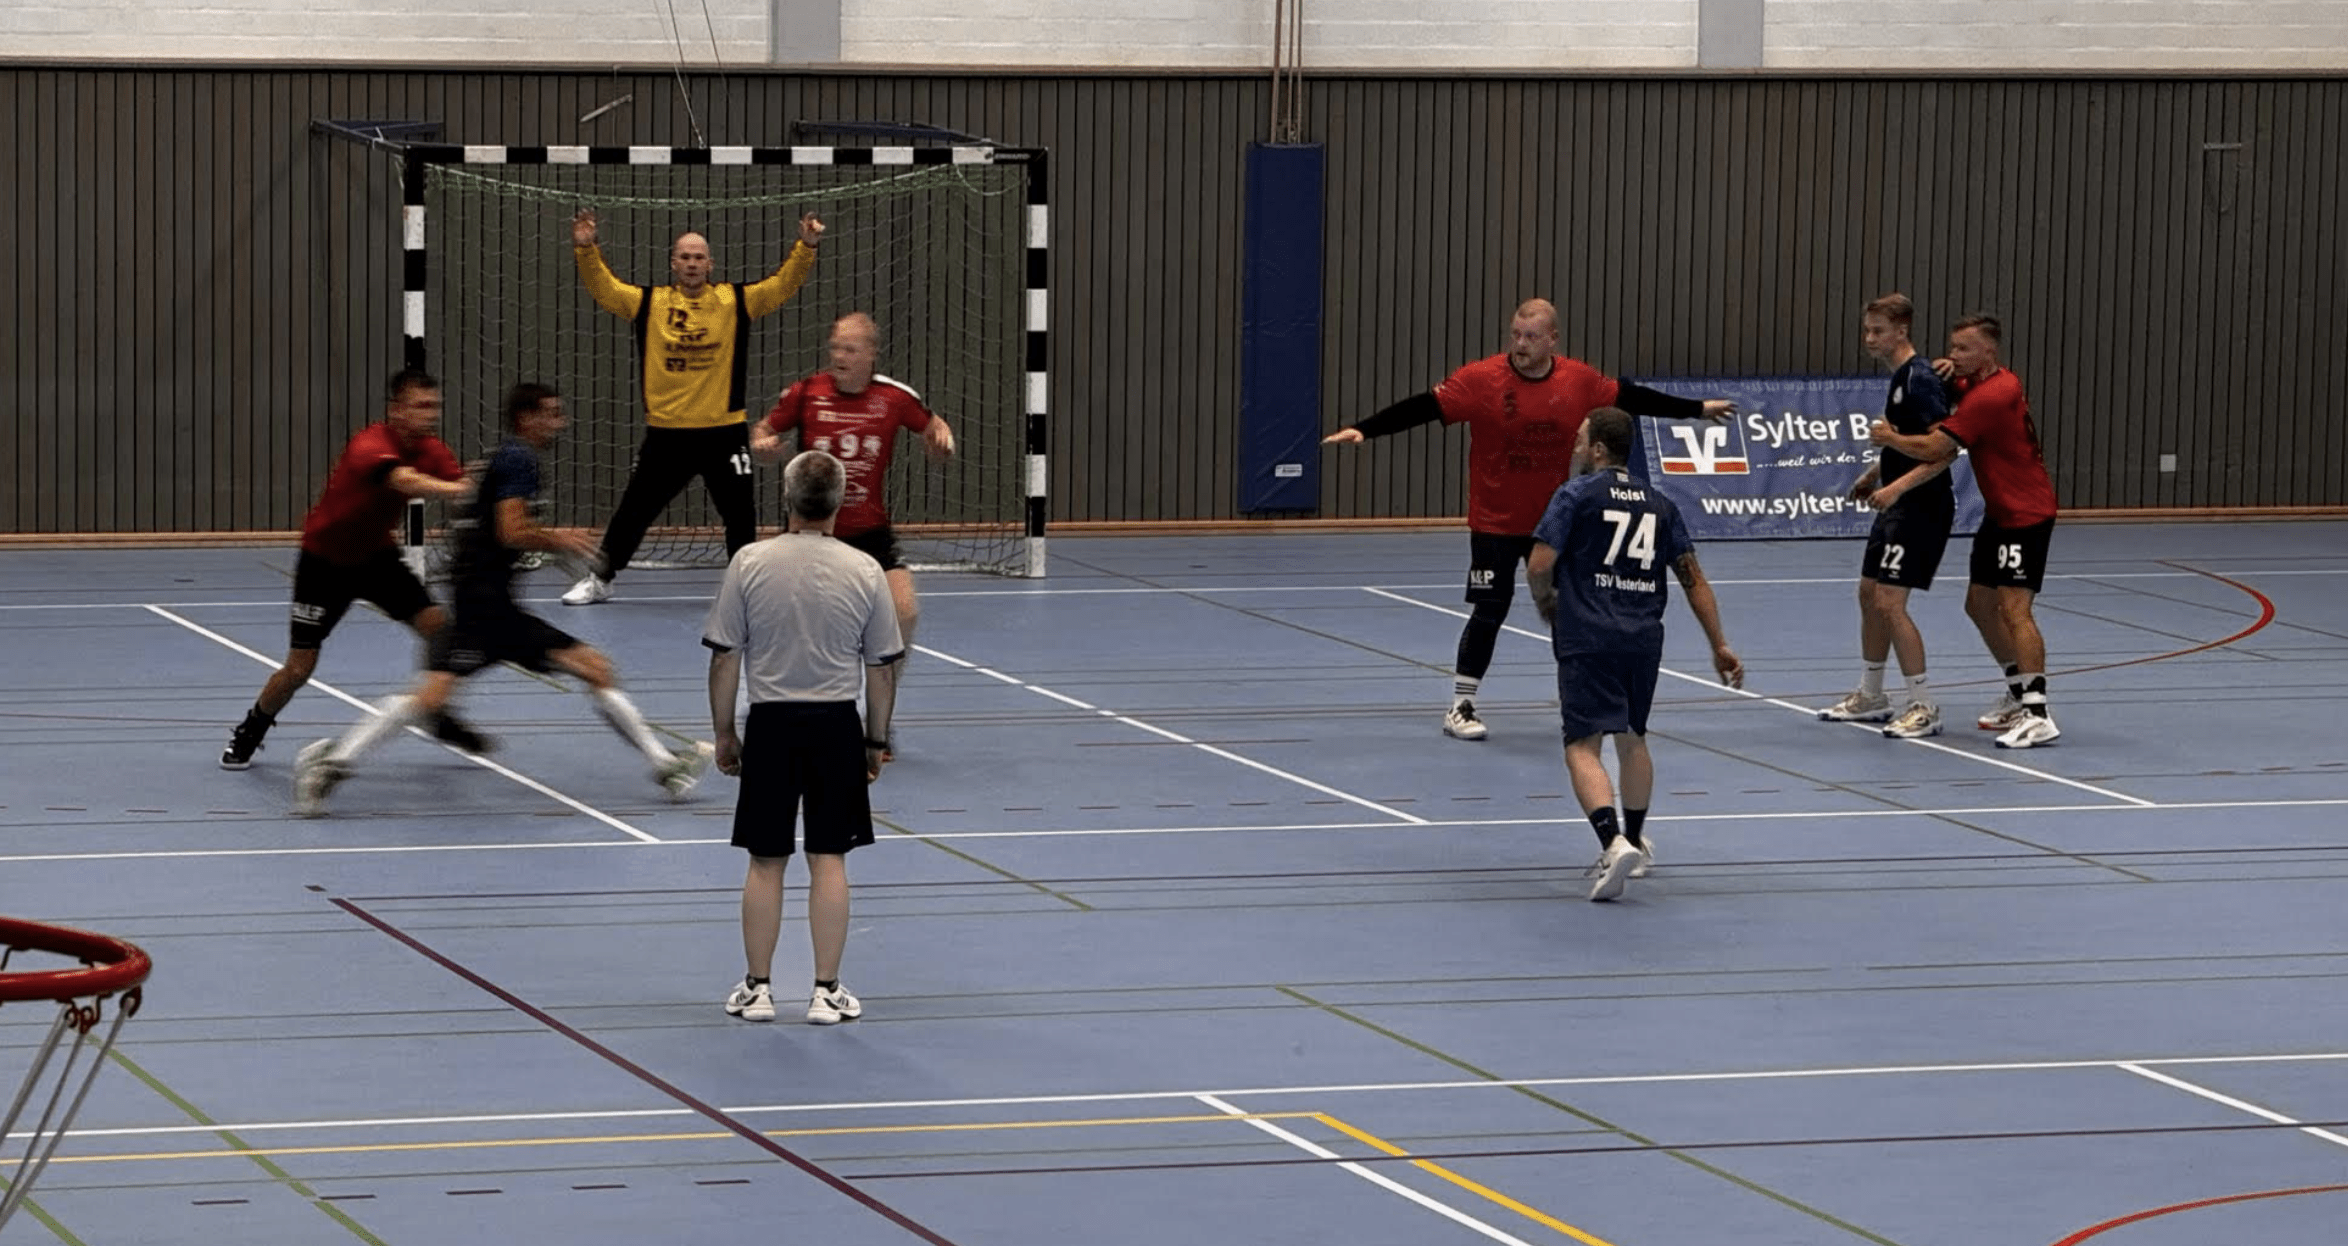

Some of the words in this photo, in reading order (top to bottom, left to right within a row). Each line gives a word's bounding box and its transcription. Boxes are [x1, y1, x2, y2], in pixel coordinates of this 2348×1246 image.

[1747, 412, 1841, 448] Sylter
[1849, 413, 1883, 440] B
[730, 452, 752, 475] 12
[1809, 454, 1832, 465] wir
[1837, 451, 1856, 463] der
[1701, 492, 1874, 520] www.sylter-b
[1603, 510, 1656, 571] 74
[1880, 543, 1904, 571] 22
[1998, 543, 2022, 569] 95
[1595, 573, 1614, 588] TSV
